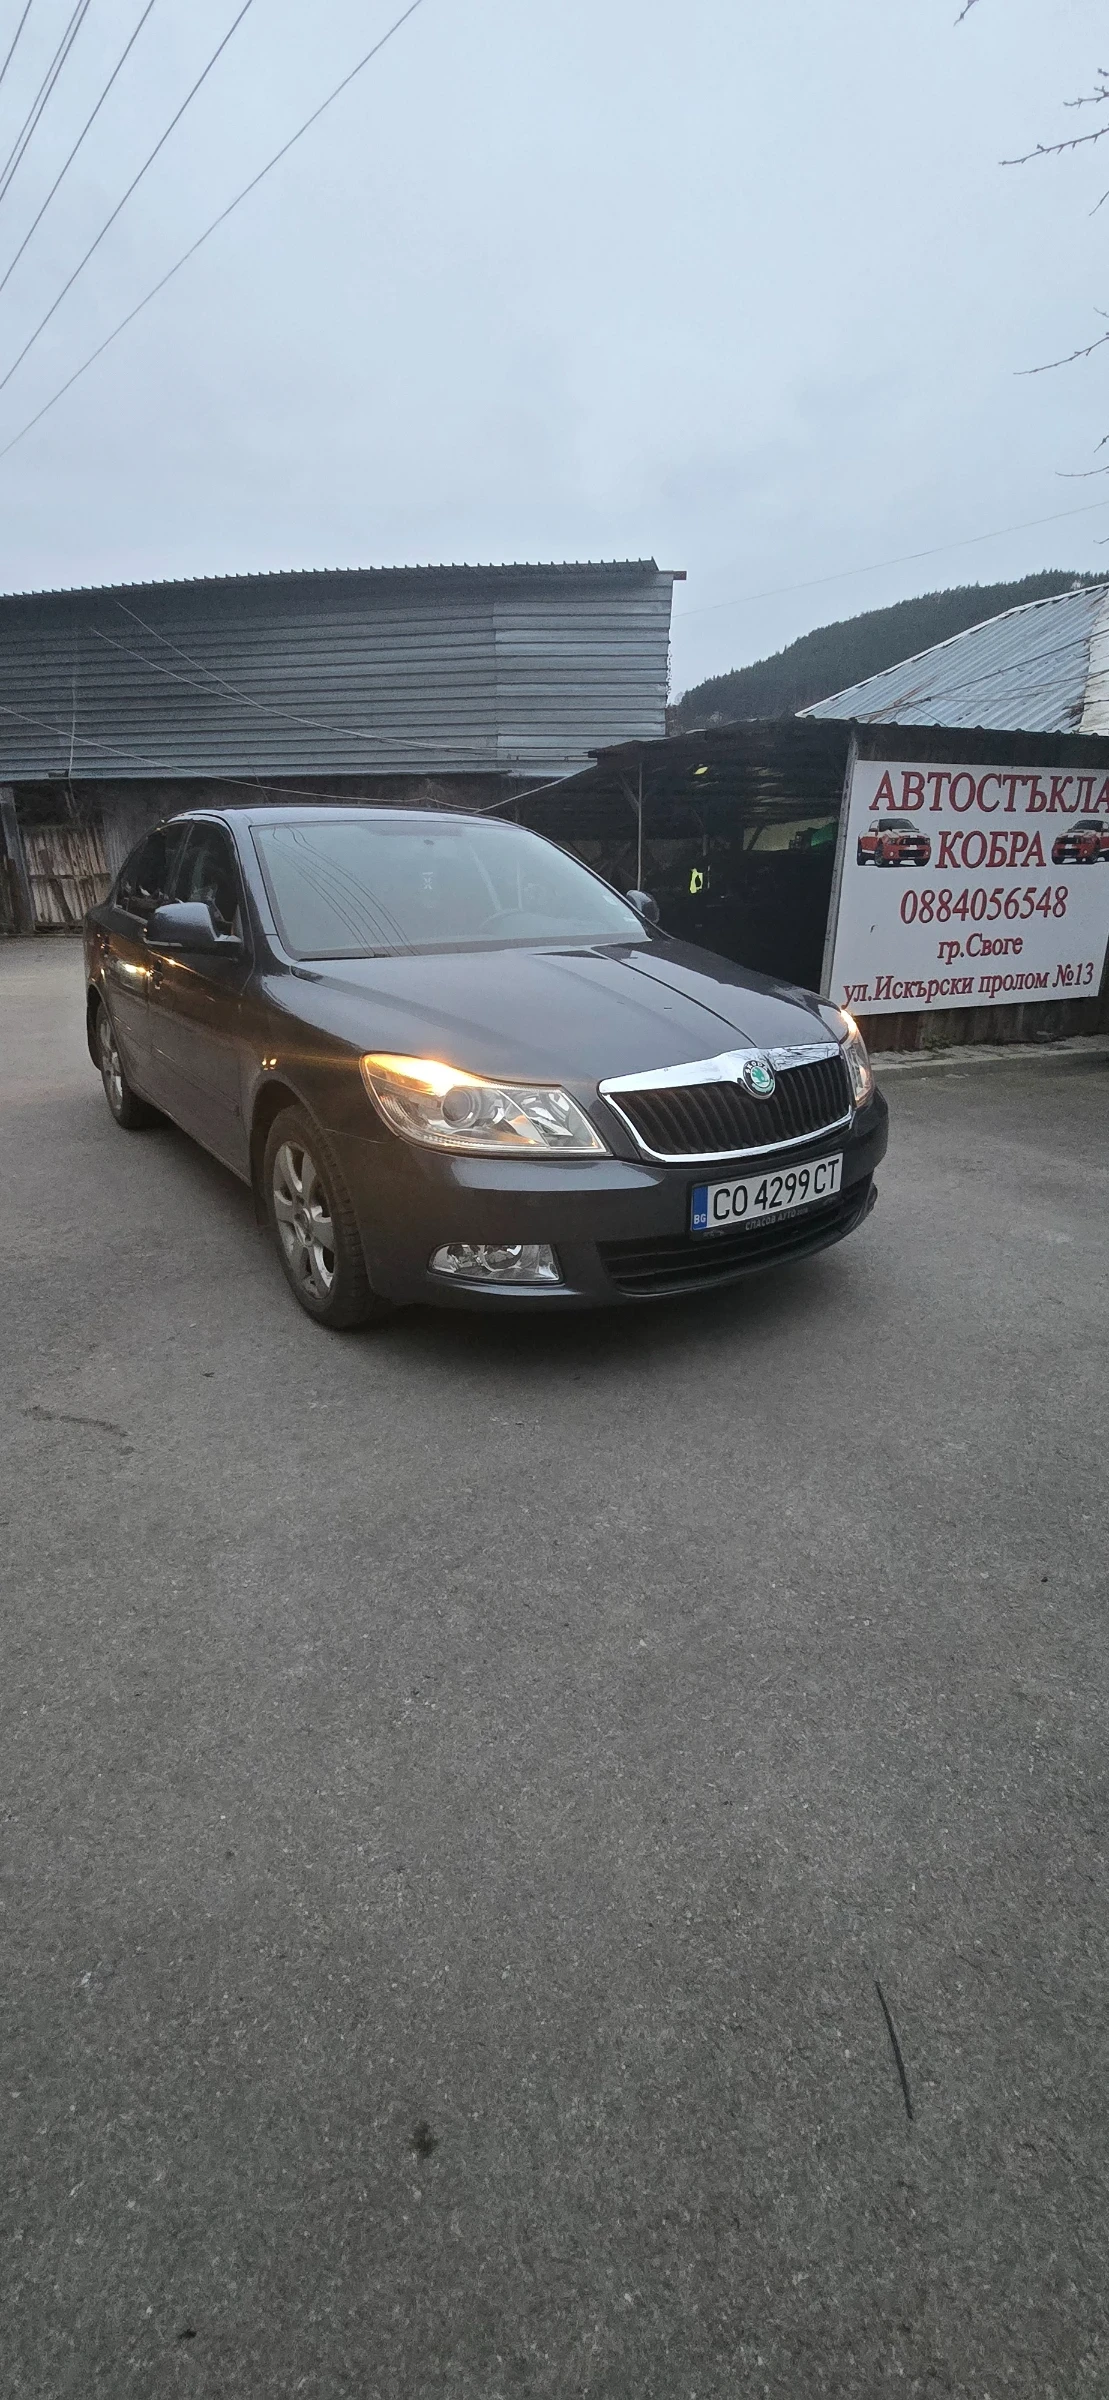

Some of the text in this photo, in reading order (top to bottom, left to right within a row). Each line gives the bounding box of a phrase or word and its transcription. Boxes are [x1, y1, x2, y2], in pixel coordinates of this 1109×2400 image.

[869, 770, 1109, 813] АВТОСТЪКЛА
[935, 830, 1046, 869] КОБРА
[900, 886, 1068, 924] 0884056548
[937, 933, 1023, 965] гр.Своге
[841, 962, 1094, 1009] ул.Искърски пролом №13
[713, 1159, 840, 1220] CO 4299 CT
[693, 1213, 706, 1225] BG
